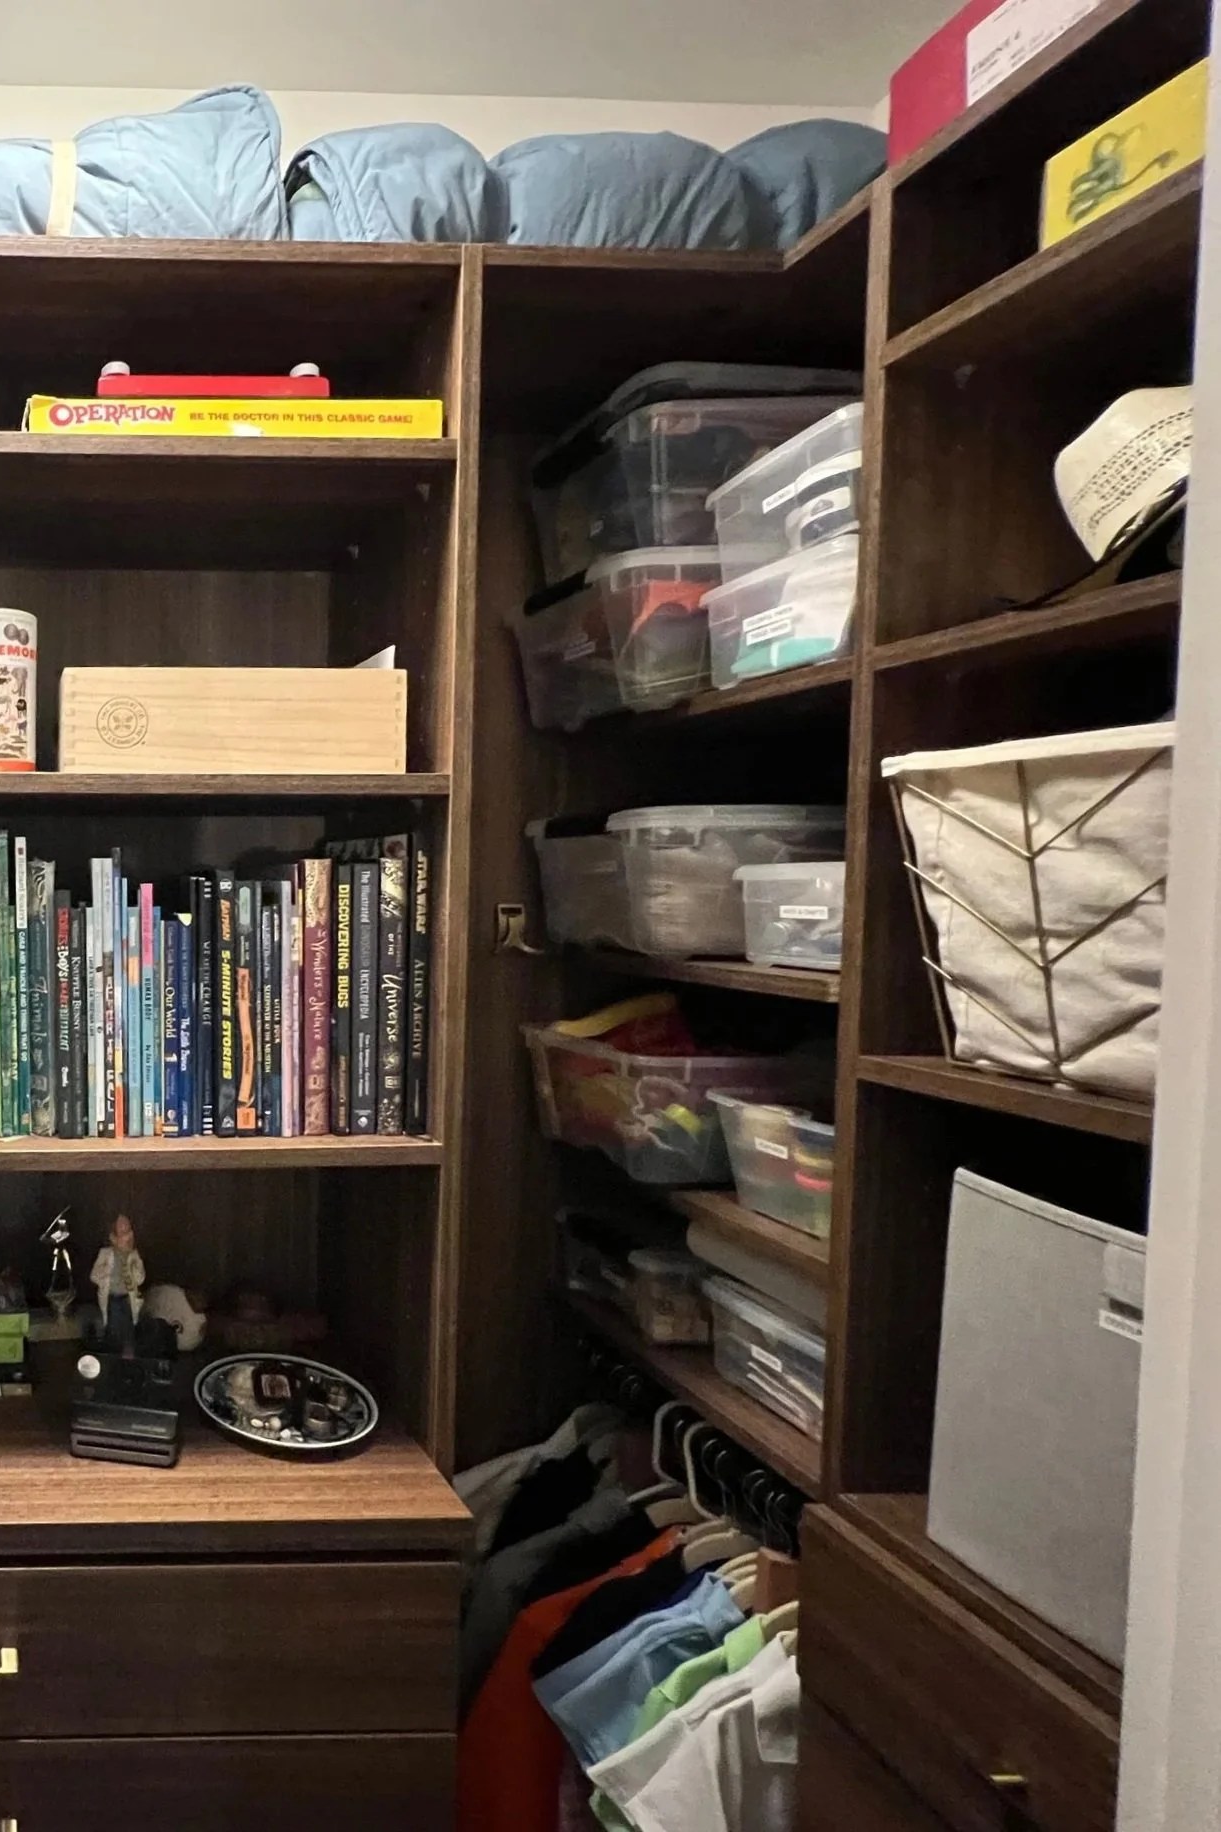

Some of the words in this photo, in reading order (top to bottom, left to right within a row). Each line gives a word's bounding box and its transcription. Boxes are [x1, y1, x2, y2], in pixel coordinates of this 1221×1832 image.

[49, 403, 175, 427] OPERATION
[208, 412, 230, 421] THE
[233, 412, 279, 421] DOCTOR
[283, 413, 294, 422] IN
[297, 413, 324, 422] THIS
[327, 414, 375, 423] CLASSIC
[360, 870, 371, 883] The
[415, 850, 428, 892] STAR
[220, 898, 231, 942] BATMAN
[360, 884, 371, 923] Illustrated
[415, 892, 428, 935] WARS
[19, 931, 27, 949] CARS
[338, 884, 349, 970] DISCOVERING
[360, 924, 371, 967] DINOSAUR
[57, 950, 70, 977] BOYS
[202, 940, 211, 954] WE
[310, 938, 327, 989] Wonders
[20, 965, 28, 993] TRUCKS
[72, 956, 82, 999] KNUFFLE
[144, 977, 152, 1000] HUMAN
[221, 949, 232, 1017] 5-MINUTE
[337, 975, 349, 1008] BUGS
[360, 969, 371, 1020] ENCYCLOPEDIA
[413, 959, 426, 998] ALIEN
[20, 994, 28, 1007] AND
[31, 975, 49, 1043] Animals
[72, 1000, 82, 1031] BUNNY
[144, 1002, 152, 1021] BODY
[165, 986, 177, 1009] Our
[202, 986, 212, 1026] CHANGE
[263, 984, 272, 1021] SLEEPOVER
[381, 972, 404, 1043] Universe
[165, 1009, 177, 1038] World
[309, 996, 327, 1041] Nature
[411, 1002, 425, 1058] ARCHIVE
[21, 1051, 28, 1062] GO
[221, 1020, 232, 1079] STORIES
[264, 1043, 272, 1073] MUSEUM
